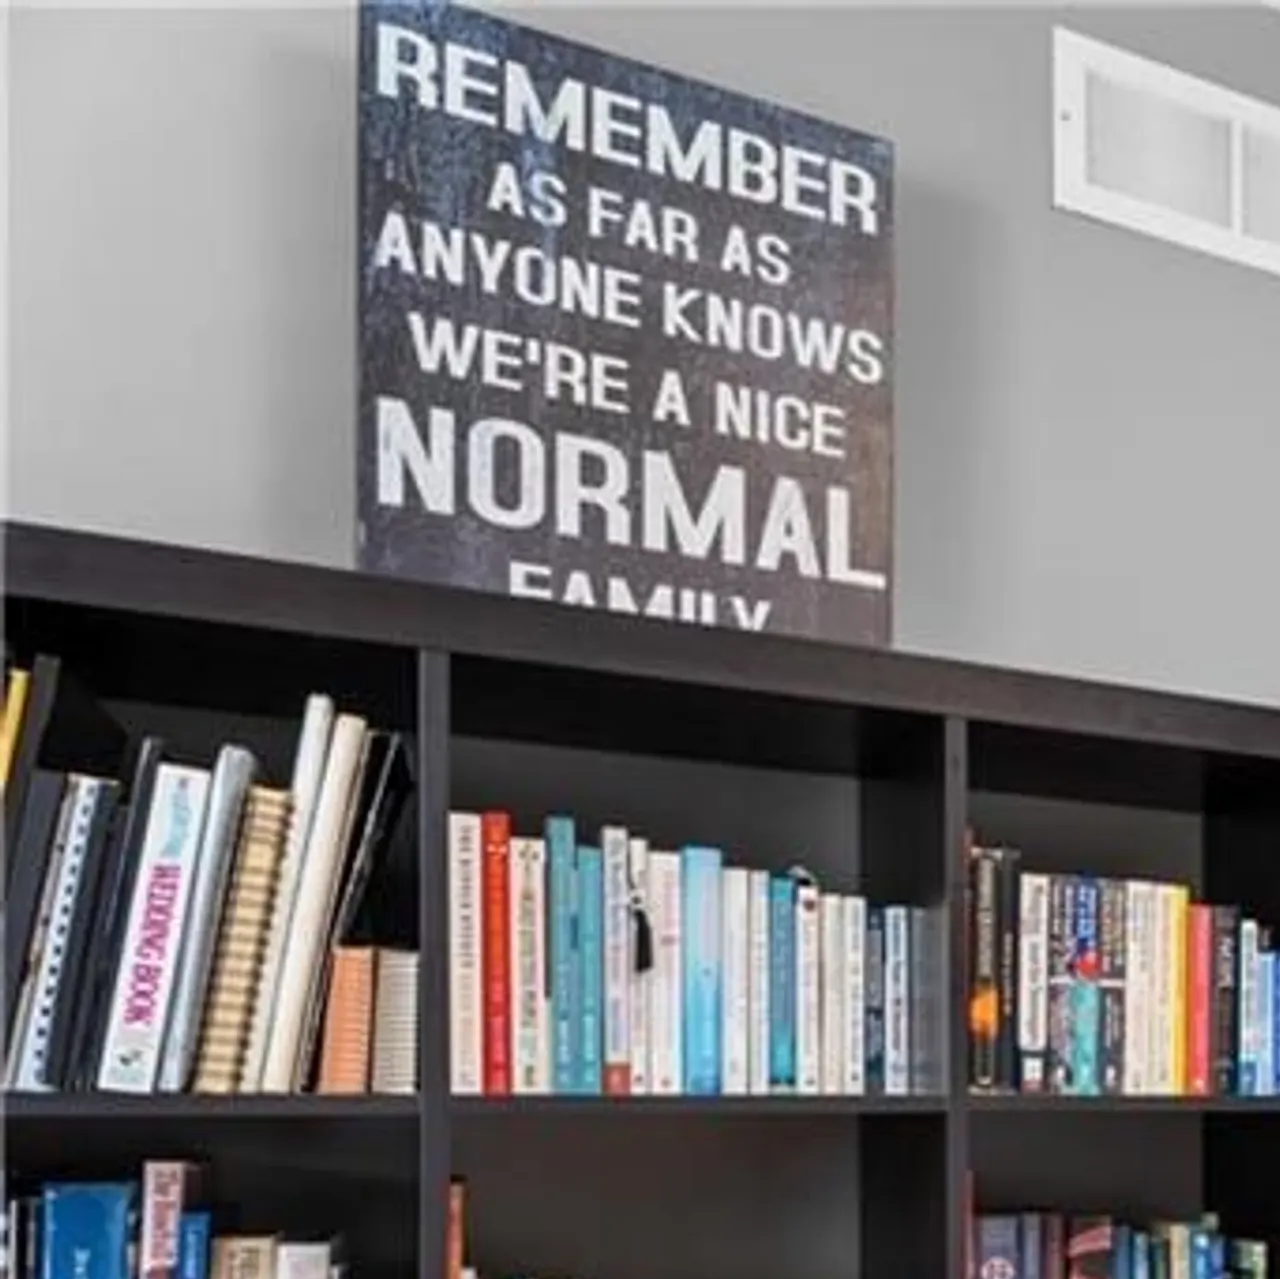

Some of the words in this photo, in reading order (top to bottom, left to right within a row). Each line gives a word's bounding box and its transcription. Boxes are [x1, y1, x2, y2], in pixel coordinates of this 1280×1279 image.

[376, 21, 879, 235] REMEMBER
[487, 161, 567, 226] AS
[588, 186, 698, 262] FAR
[720, 226, 790, 284] AS
[373, 211, 640, 326] ANYONE
[663, 282, 883, 384] KNOWS
[406, 311, 630, 413] WE'RE
[653, 371, 691, 426] A
[715, 382, 845, 457] NICE
[376, 396, 887, 589] NORMAL
[138, 864, 181, 964] WEDDING
[123, 962, 162, 1029] BOOK
